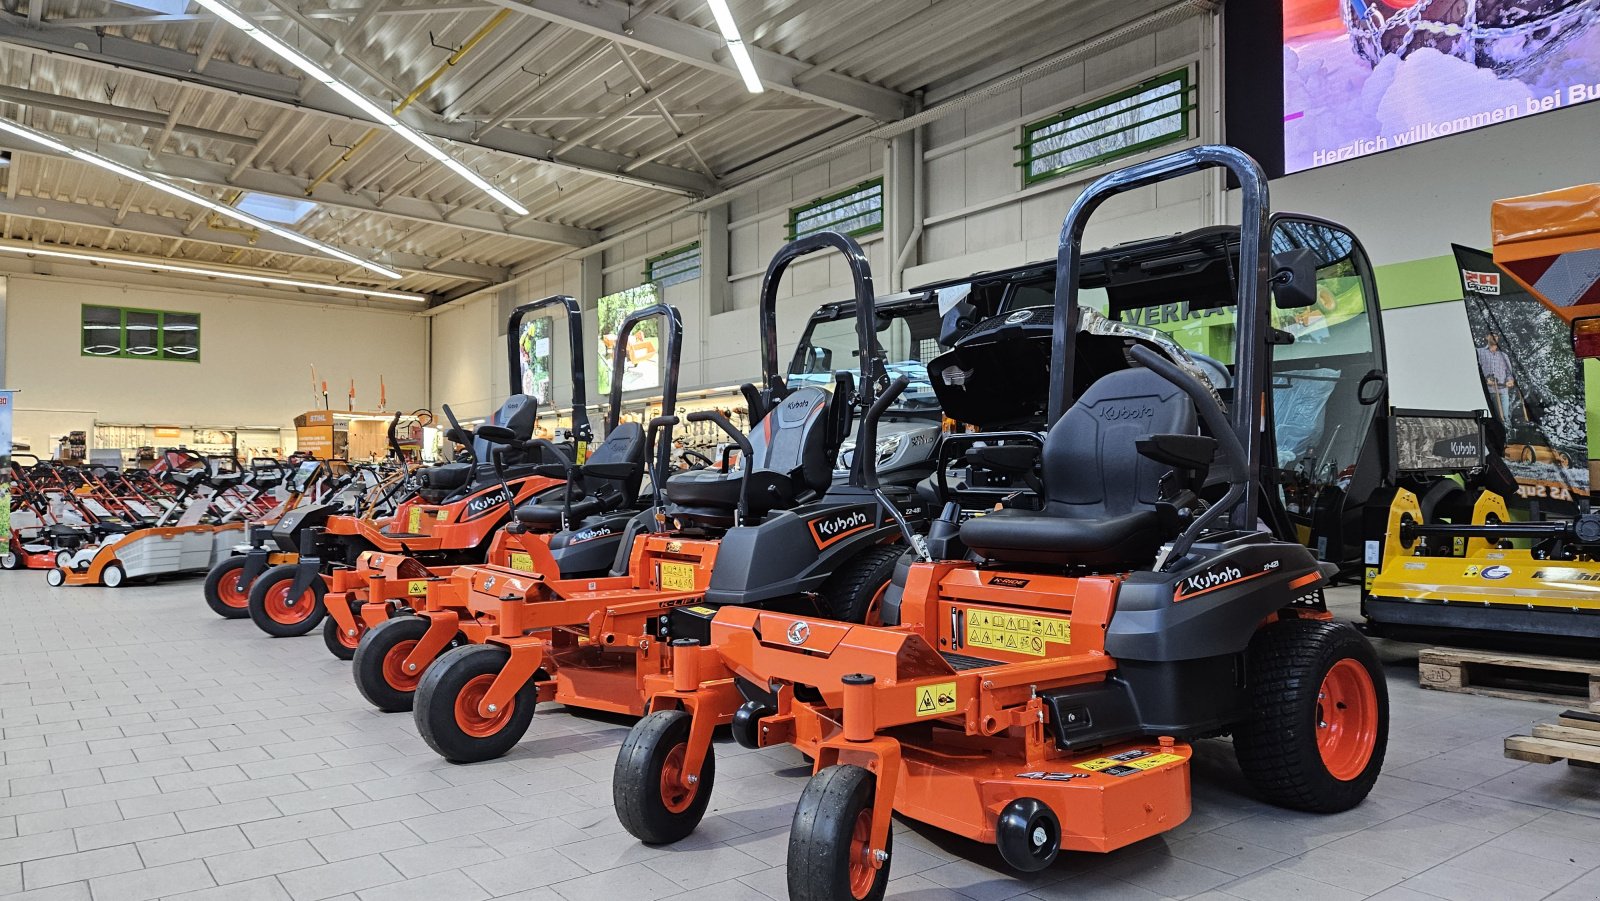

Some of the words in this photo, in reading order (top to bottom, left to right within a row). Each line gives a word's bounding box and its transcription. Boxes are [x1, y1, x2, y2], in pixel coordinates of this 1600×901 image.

[1312, 135, 1388, 167] Herzlich
[1393, 103, 1519, 148] willkommen
[1526, 90, 1562, 115] bei
[1099, 404, 1154, 421] Kubota
[1451, 442, 1477, 455] Kubota
[818, 511, 867, 535] Kubota
[578, 527, 611, 541] Kubota
[1188, 566, 1242, 590] Kubota
